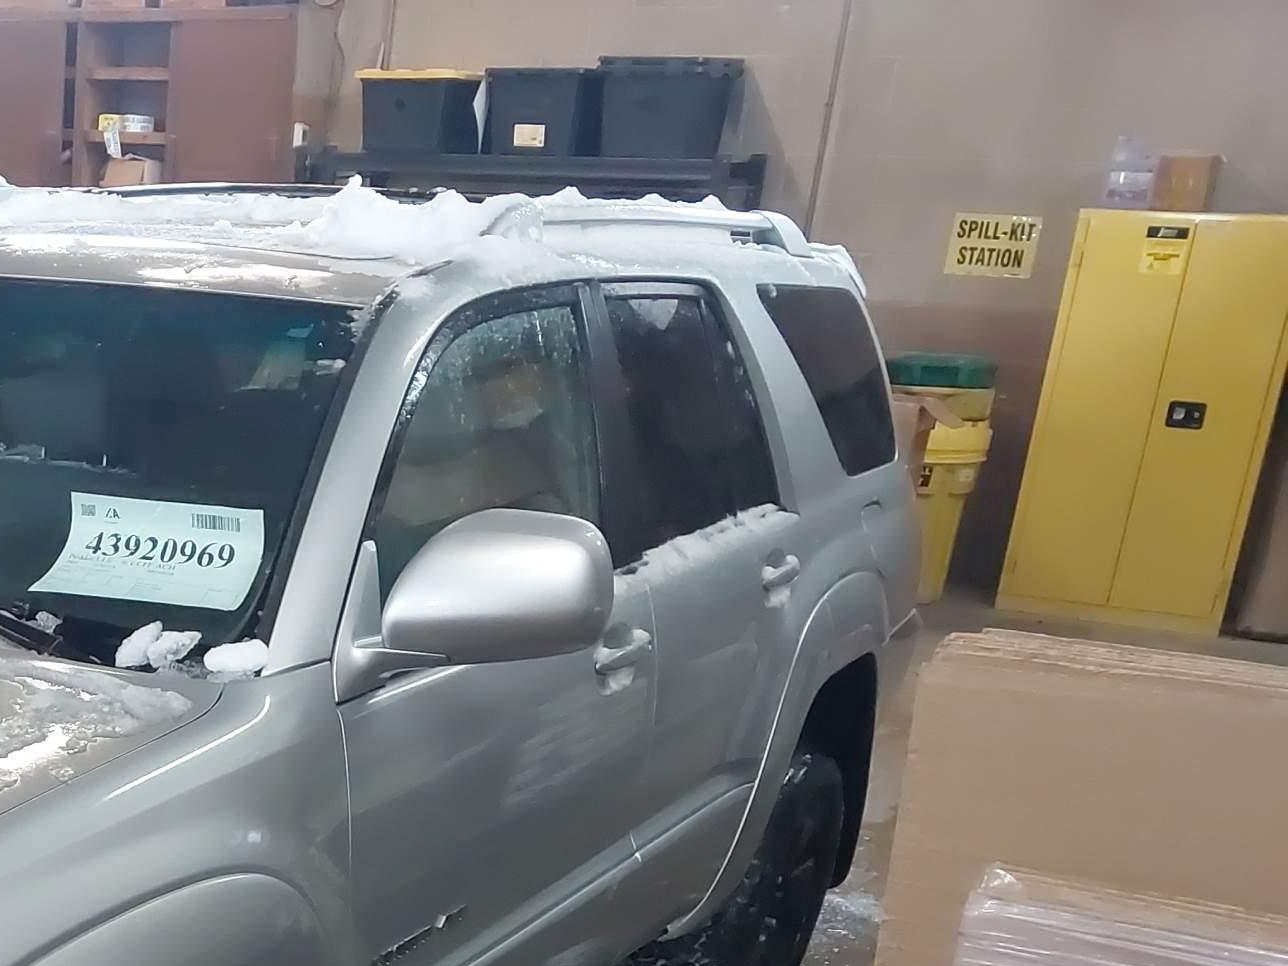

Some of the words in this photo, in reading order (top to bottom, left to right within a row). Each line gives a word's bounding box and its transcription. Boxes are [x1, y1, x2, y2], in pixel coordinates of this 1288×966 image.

[956, 219, 1037, 242] SPILL-KIT
[956, 245, 1025, 268] STATION
[84, 531, 236, 569] 43920969
